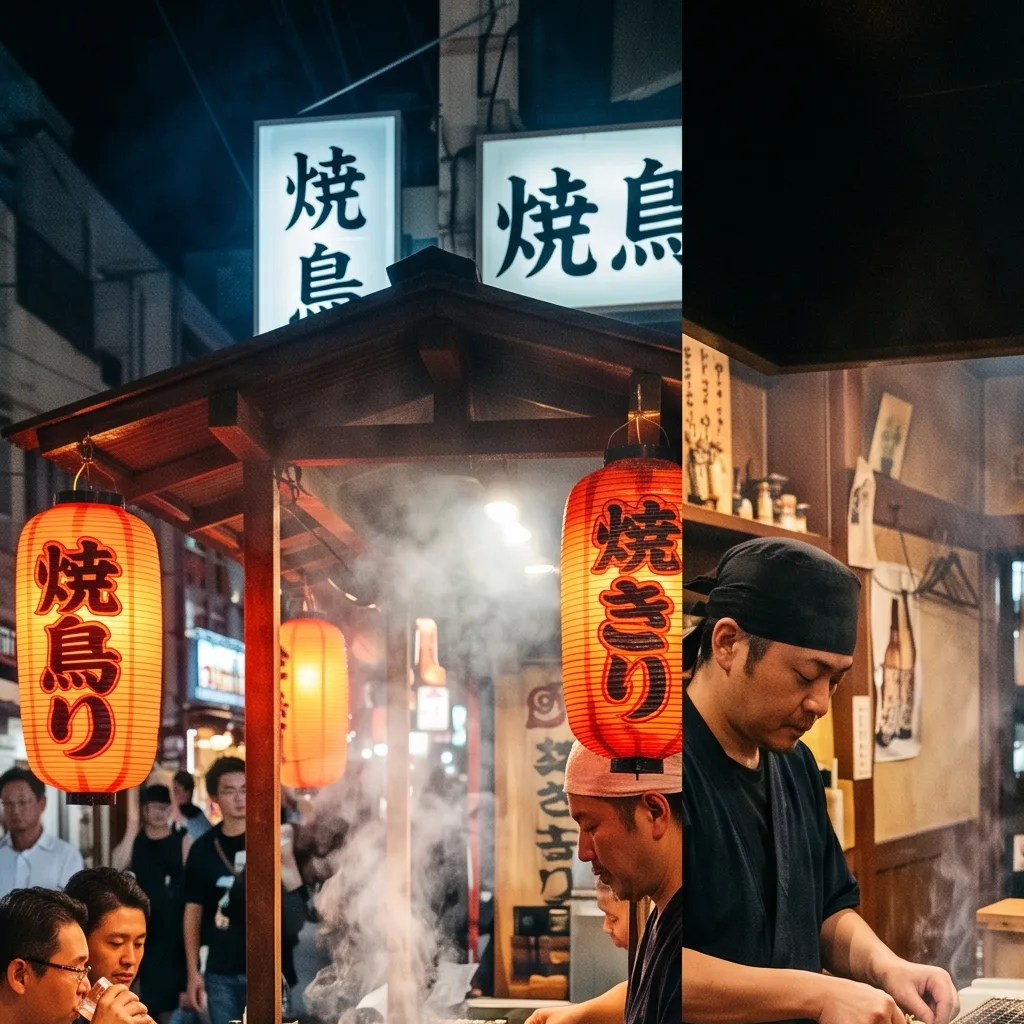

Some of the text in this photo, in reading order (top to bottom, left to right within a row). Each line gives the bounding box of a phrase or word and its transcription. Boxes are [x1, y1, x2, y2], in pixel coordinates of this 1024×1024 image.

[284, 145, 367, 324] 焼鳥
[495, 157, 682, 279] 焼鳥
[35, 537, 122, 759] 焼鳥り
[592, 496, 682, 722] 焼きり
